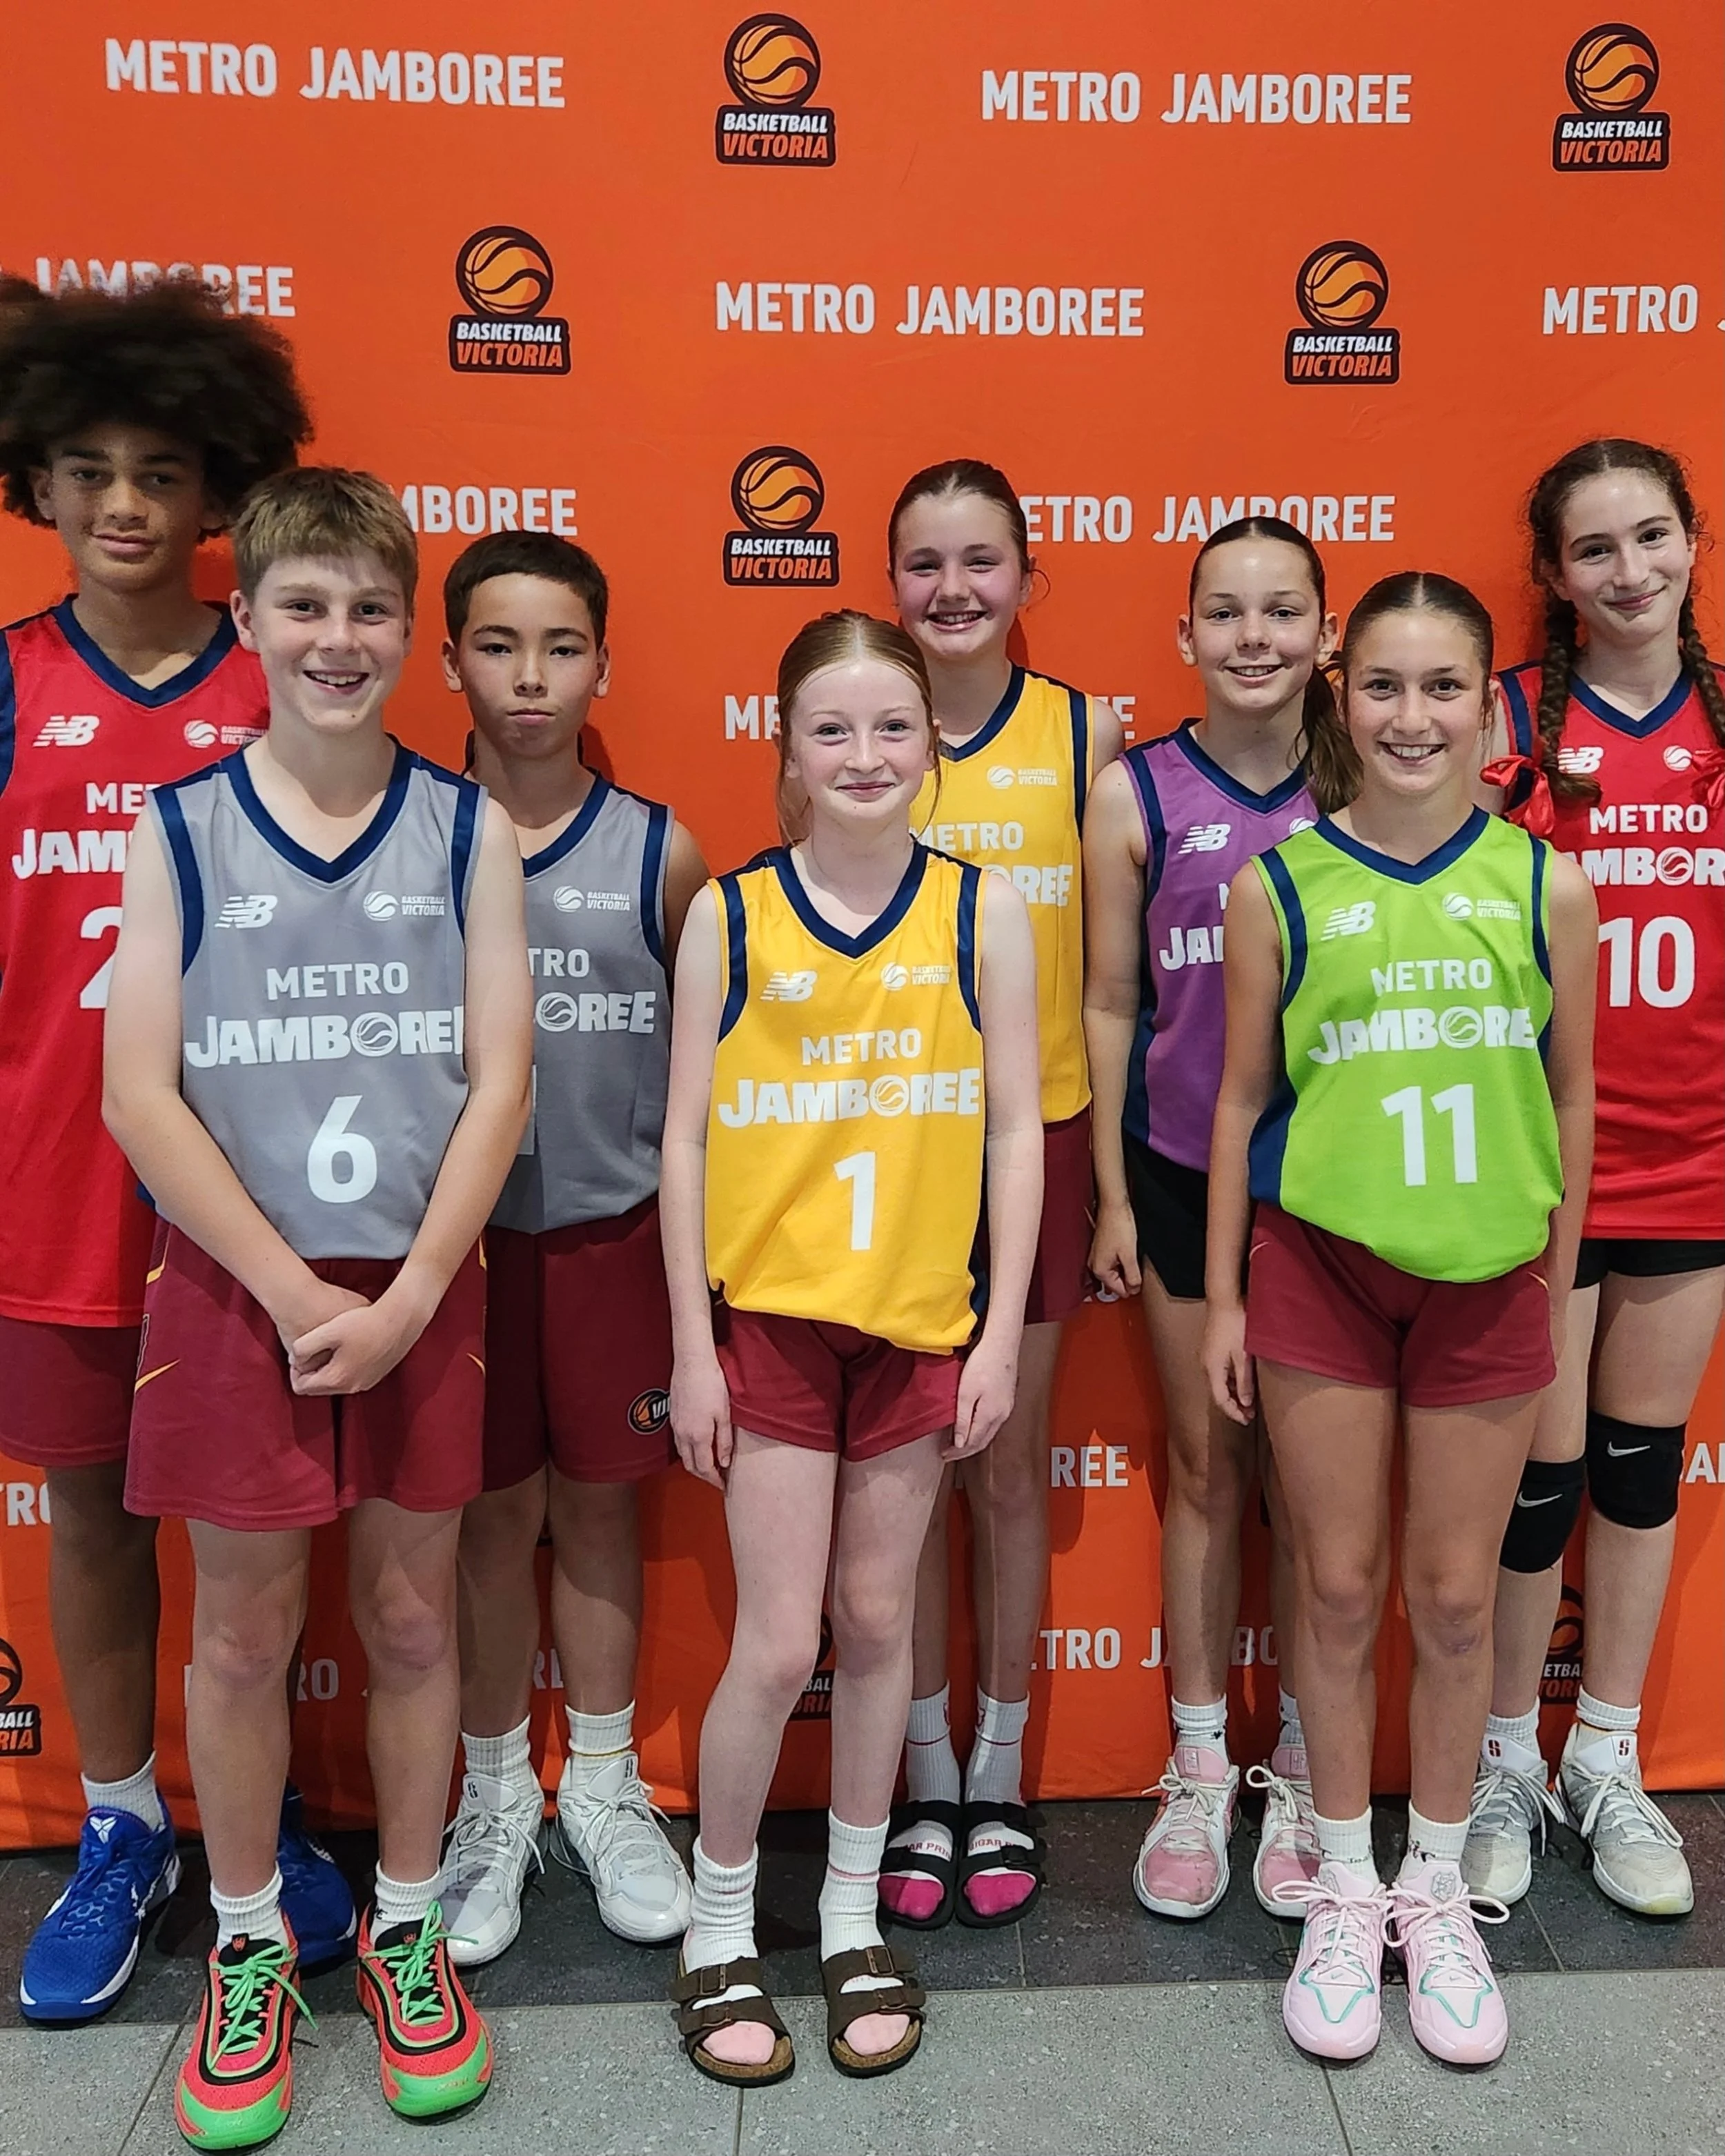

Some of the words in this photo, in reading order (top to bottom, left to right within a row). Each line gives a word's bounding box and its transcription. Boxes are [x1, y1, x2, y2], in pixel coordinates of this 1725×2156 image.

[106, 38, 277, 97] METRO
[299, 47, 565, 108] JAMBOREE
[982, 70, 1141, 123] METRO
[1161, 73, 1412, 124] JAMBOREE
[724, 113, 828, 134] BASKETBALL
[1561, 121, 1663, 138] BASKETBALL
[722, 133, 828, 159] VICTORIA
[1560, 140, 1662, 164] VICTORIA
[716, 282, 875, 333] METRO
[896, 286, 1144, 336] JAMBOREE
[1543, 284, 1698, 334] METRO
[457, 322, 562, 342] BASKETBALL
[1292, 335, 1392, 353] BASKETBALL
[457, 343, 563, 367] VICTORIA
[1292, 355, 1392, 377] VICTORIA
[731, 538, 831, 556] BASKETBALL
[730, 556, 831, 580] VICTORIA
[1590, 804, 1708, 834] METRO
[402, 904, 445, 916] VICTORIA
[586, 900, 630, 911] VICTORIA
[1371, 958, 1492, 997] METRO
[1598, 916, 1695, 1008] 10
[266, 962, 409, 1000] METRO
[802, 1029, 921, 1066] METRO
[718, 1068, 980, 1129] JAMBOREE
[307, 1096, 377, 1204] 6
[1381, 1083, 1478, 1187] 11
[834, 1151, 877, 1251] 1
[1031, 1628, 1121, 1670] TRO
